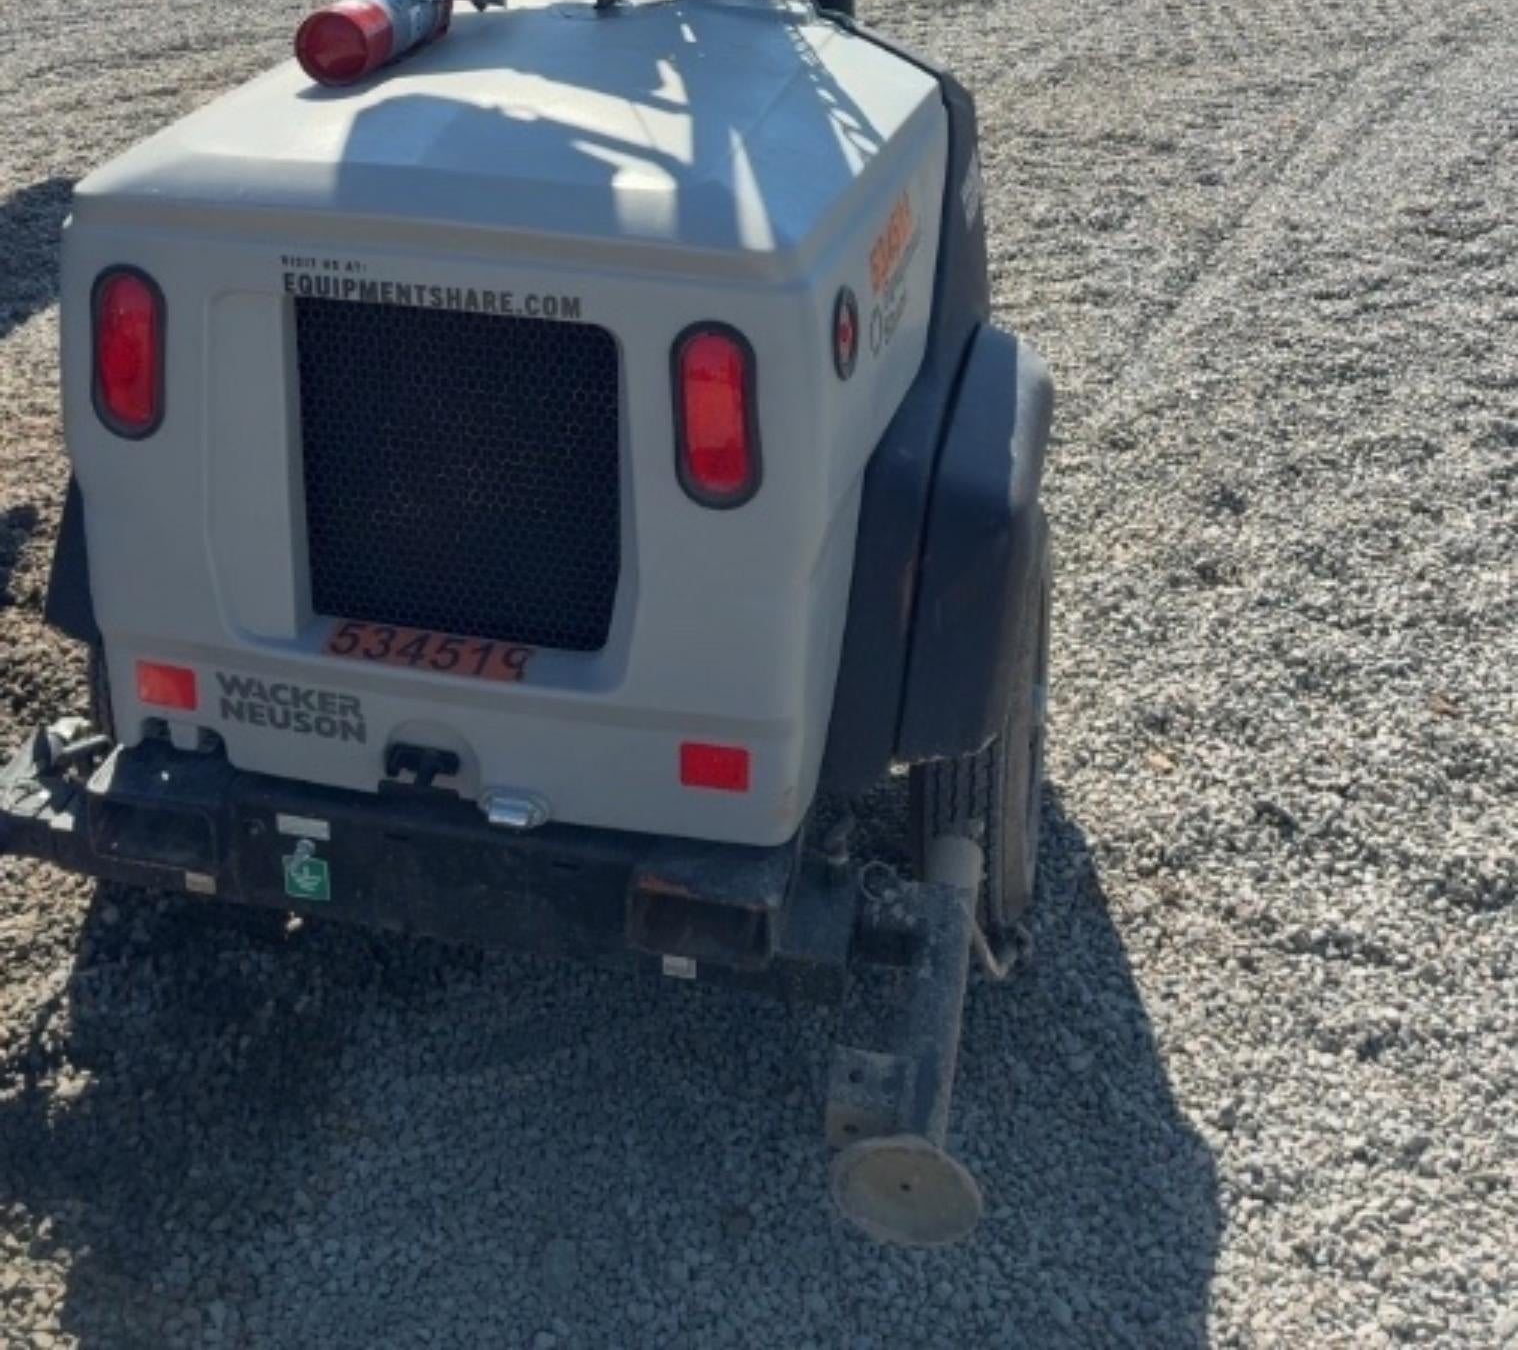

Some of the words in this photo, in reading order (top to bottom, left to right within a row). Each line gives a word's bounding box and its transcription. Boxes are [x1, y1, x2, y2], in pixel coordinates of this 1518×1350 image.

[283, 271, 582, 319] EQUIPMENTSHARE.COM
[328, 621, 535, 682] 534519
[215, 671, 364, 722] WACKER
[220, 697, 367, 745] NEUSON
